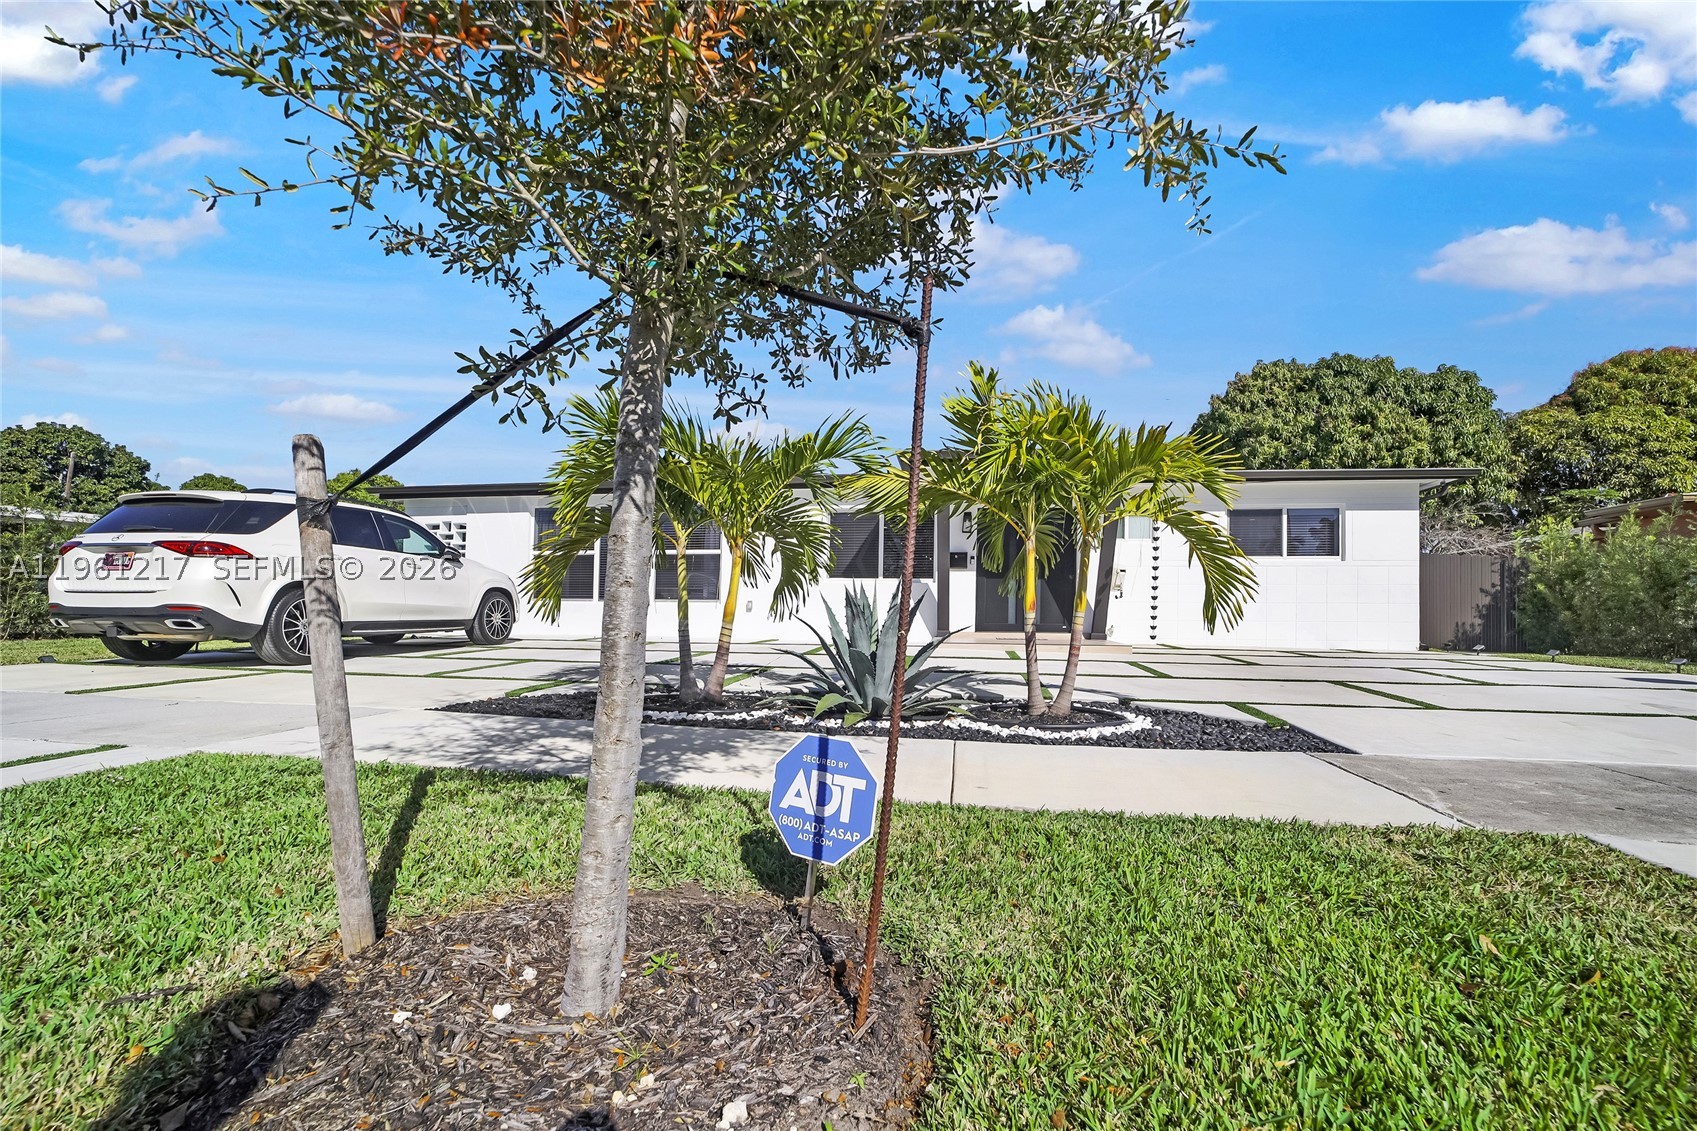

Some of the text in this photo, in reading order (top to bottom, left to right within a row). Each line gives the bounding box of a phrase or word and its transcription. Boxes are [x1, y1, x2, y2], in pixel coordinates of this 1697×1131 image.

[802, 754, 849, 769] SECURED BY
[779, 768, 867, 824] ADT
[779, 813, 861, 843] (800) ADT-ASAP
[797, 832, 833, 847] ADT.COM
